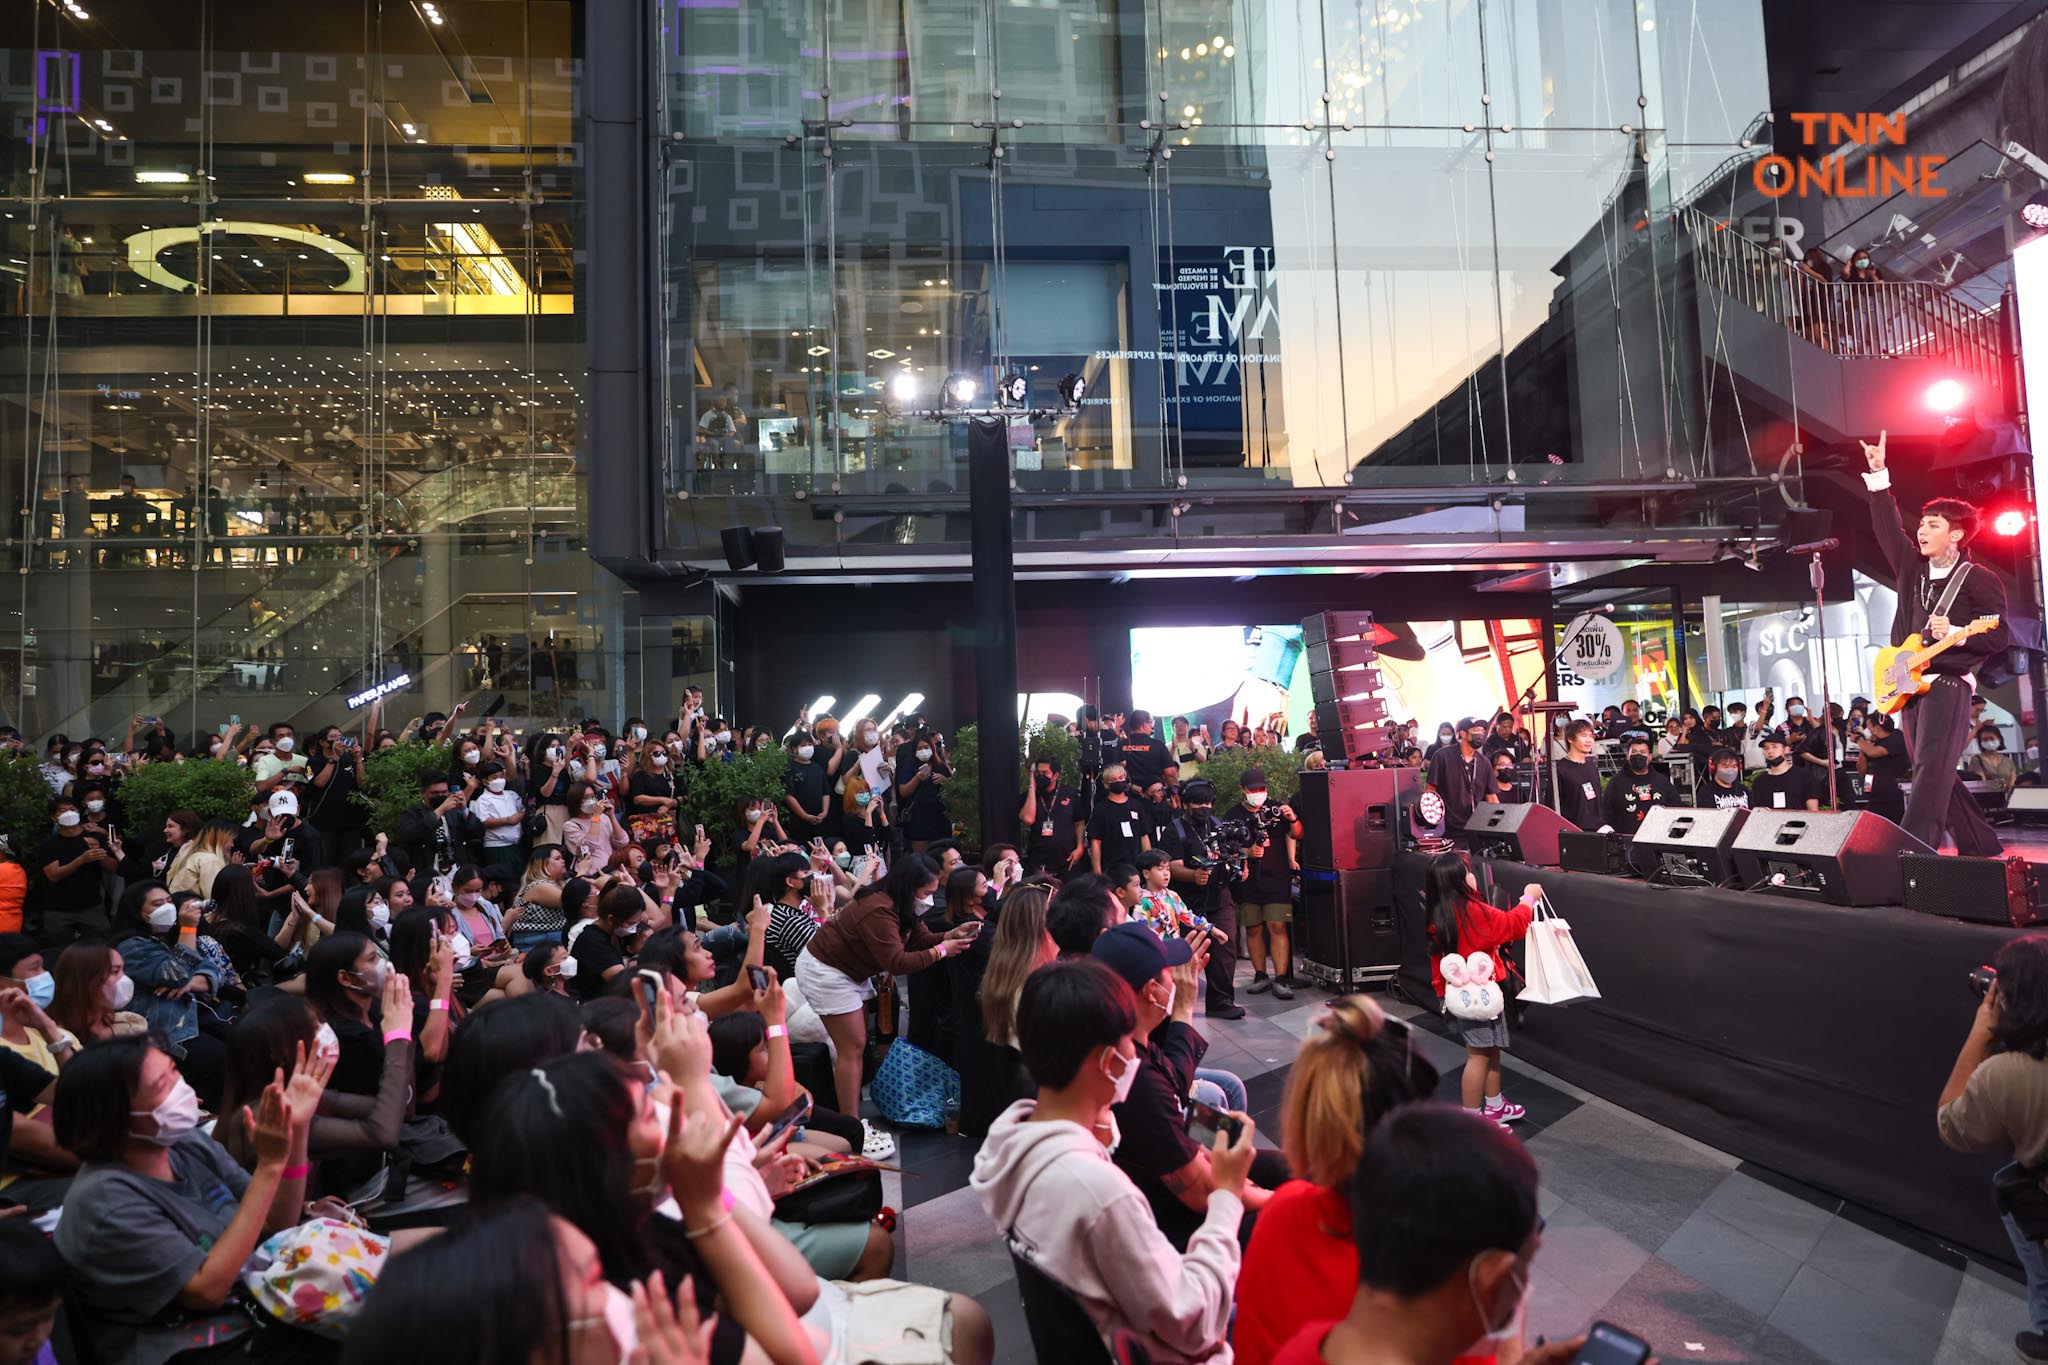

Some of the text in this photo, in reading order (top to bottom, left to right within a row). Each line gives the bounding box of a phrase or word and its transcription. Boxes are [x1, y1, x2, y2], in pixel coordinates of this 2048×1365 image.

[1576, 633, 1611, 658] 30%
[348, 674, 411, 708] PAPER PLANES
